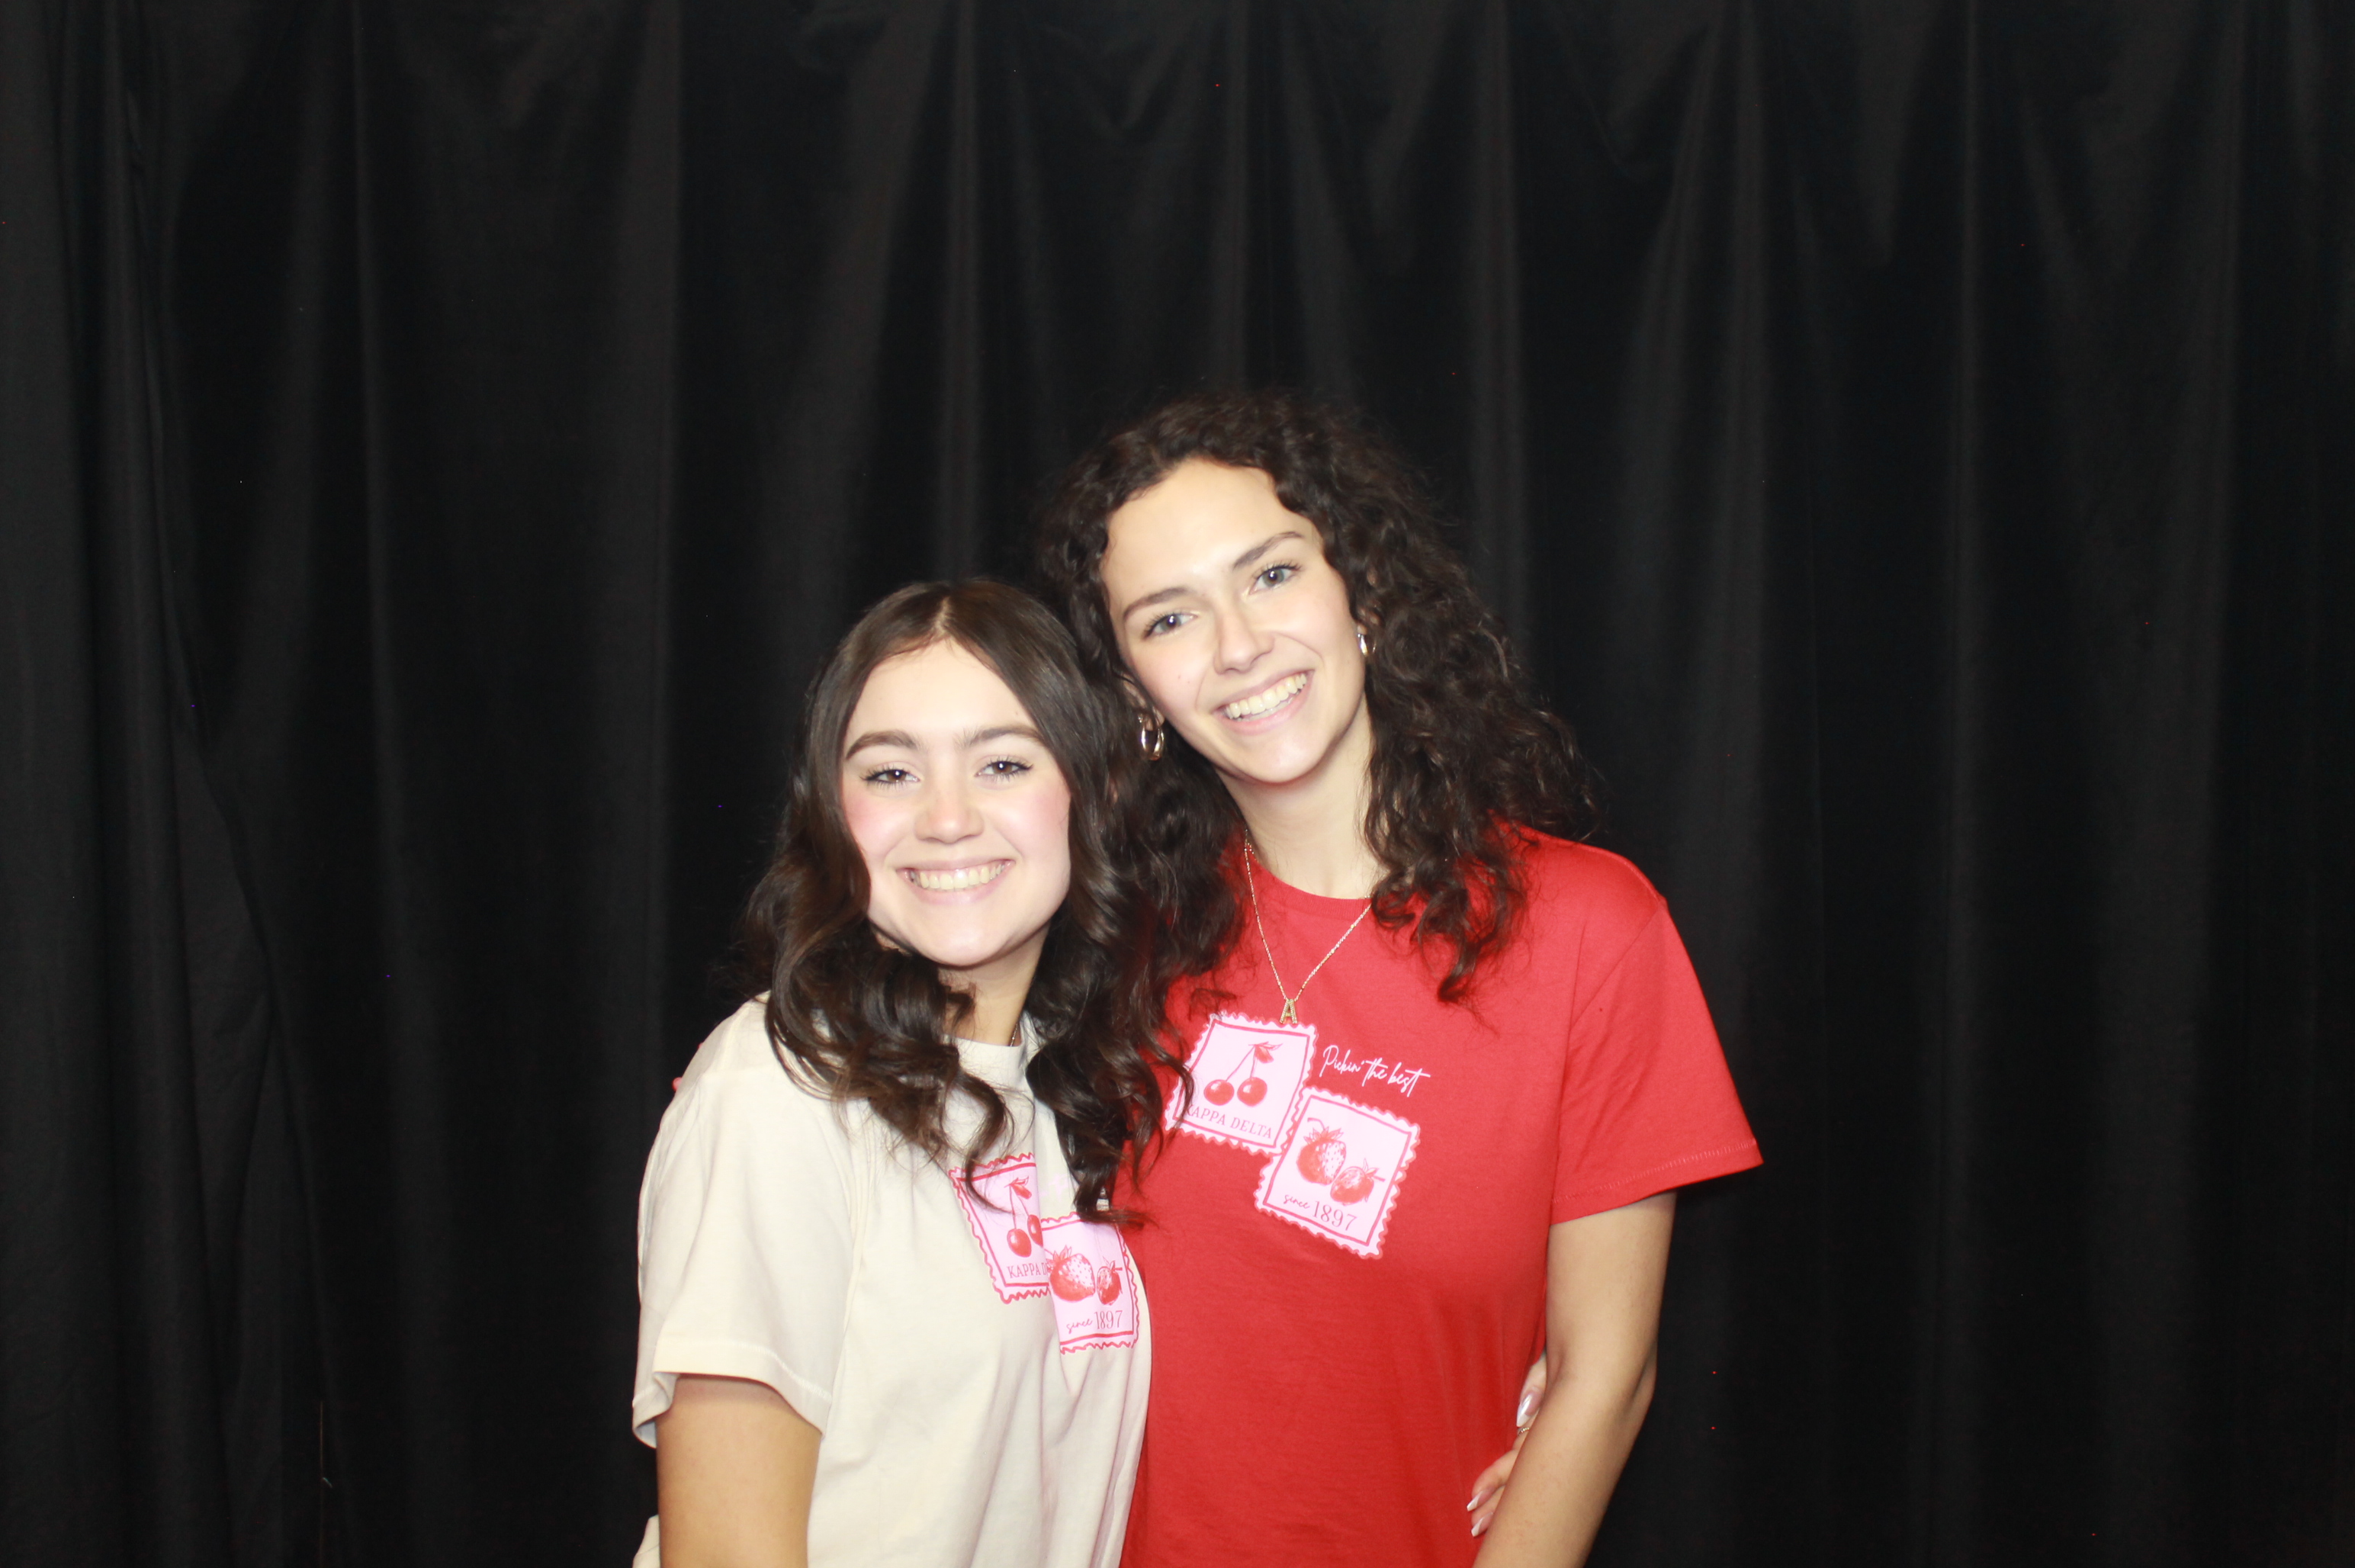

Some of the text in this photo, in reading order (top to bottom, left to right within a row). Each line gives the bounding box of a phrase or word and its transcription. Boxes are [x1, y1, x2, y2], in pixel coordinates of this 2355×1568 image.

[1280, 998, 1297, 1023] A
[1361, 1057, 1388, 1087] the
[1387, 1062, 1431, 1097] best
[1230, 1117, 1272, 1139] DELTA
[1284, 1194, 1357, 1231] since 1897
[1007, 1262, 1041, 1278] KAPPA
[1066, 1309, 1123, 1334] since 1897
